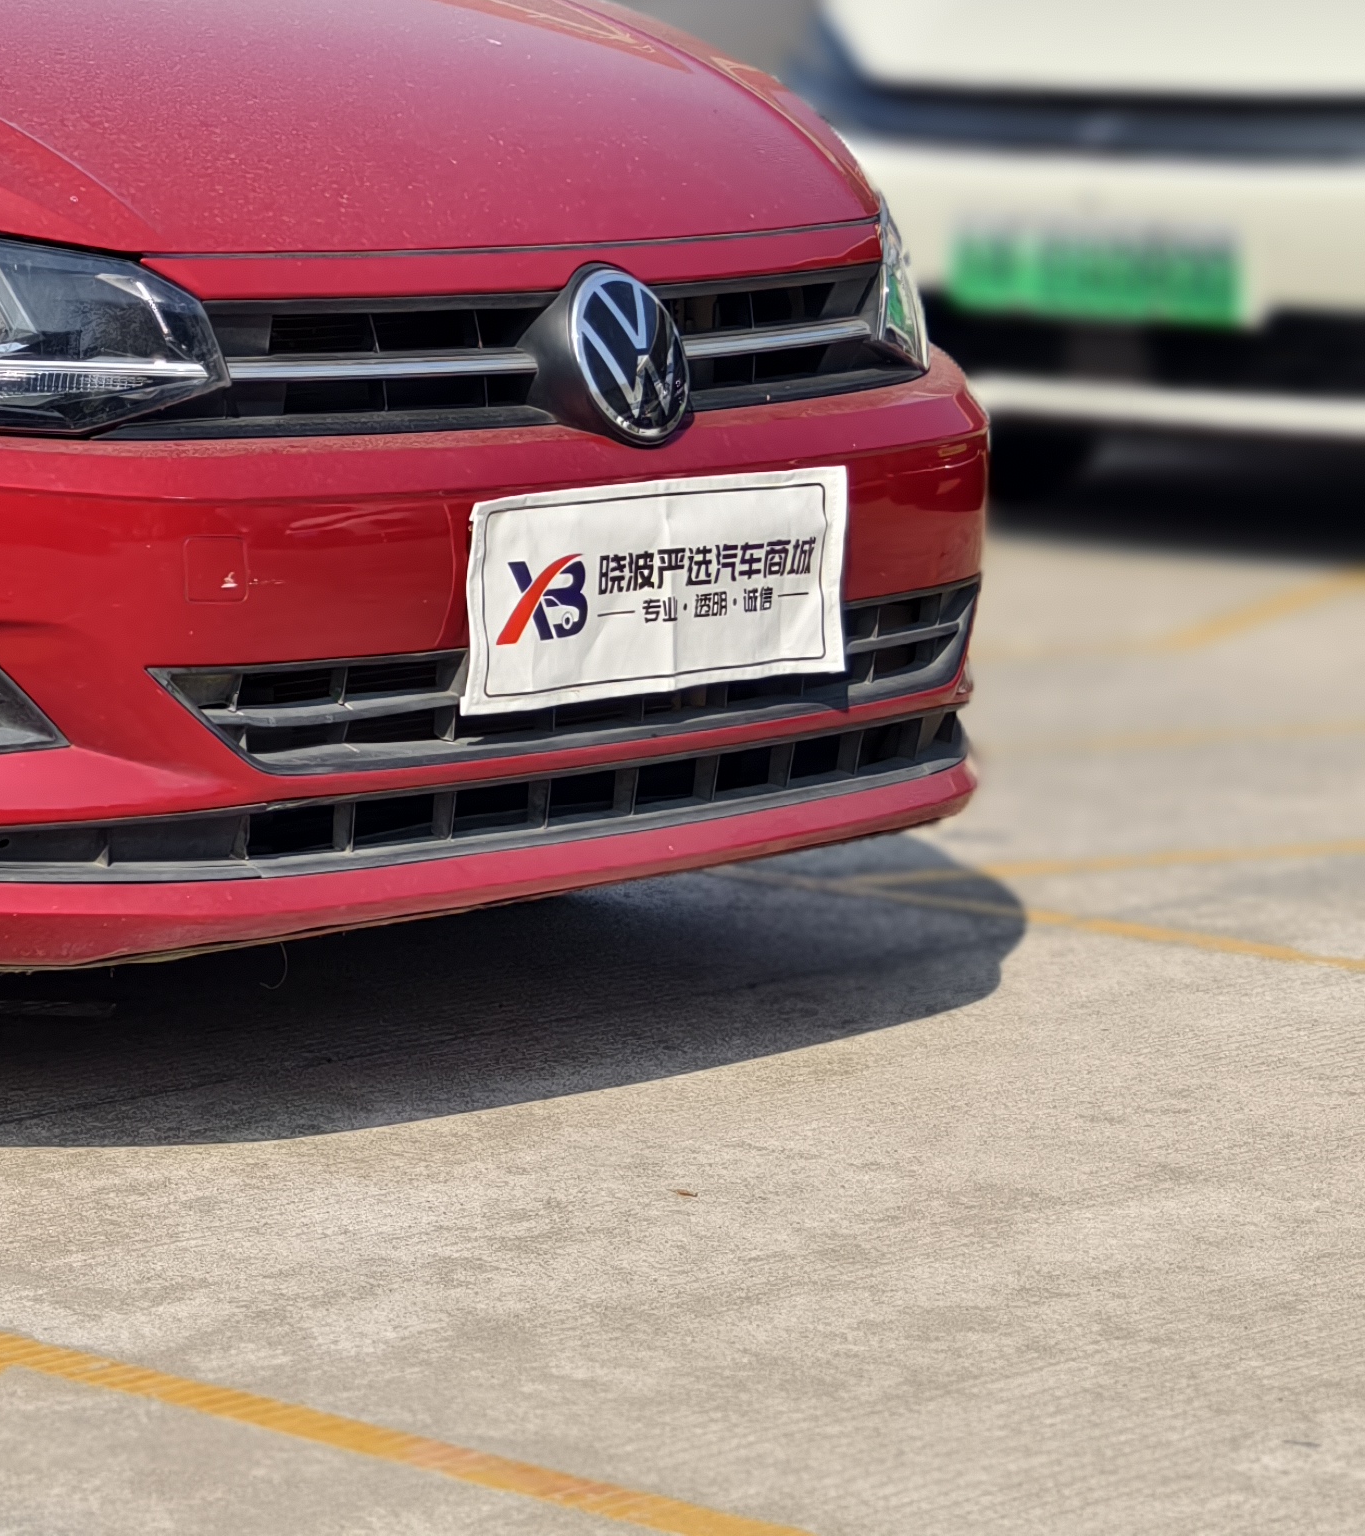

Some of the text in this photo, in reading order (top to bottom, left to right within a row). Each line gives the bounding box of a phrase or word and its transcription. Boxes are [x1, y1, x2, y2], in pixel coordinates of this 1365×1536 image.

[598, 536, 816, 595] 晓波严选汽车商城
